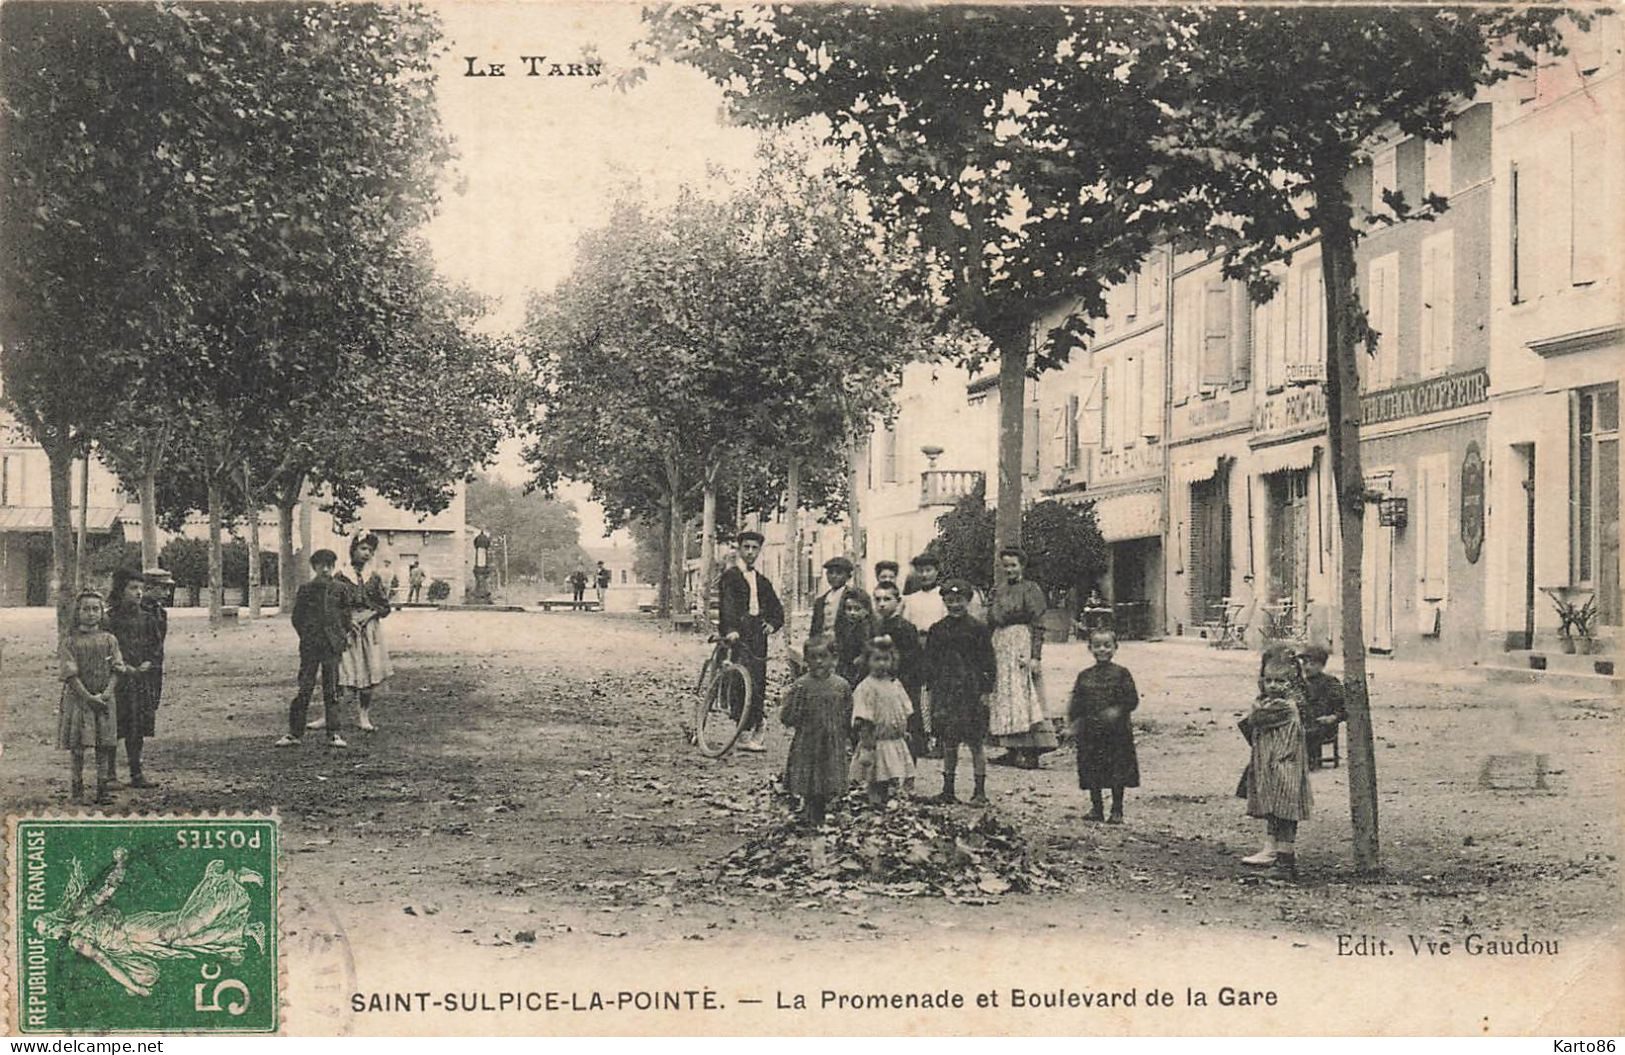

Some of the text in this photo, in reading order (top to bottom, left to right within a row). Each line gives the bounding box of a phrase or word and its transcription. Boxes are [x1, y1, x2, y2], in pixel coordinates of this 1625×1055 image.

[1416, 372, 1487, 415] COIFFEUR
[177, 829, 261, 849] POSTES
[26, 830, 48, 911] FRANÇAISE
